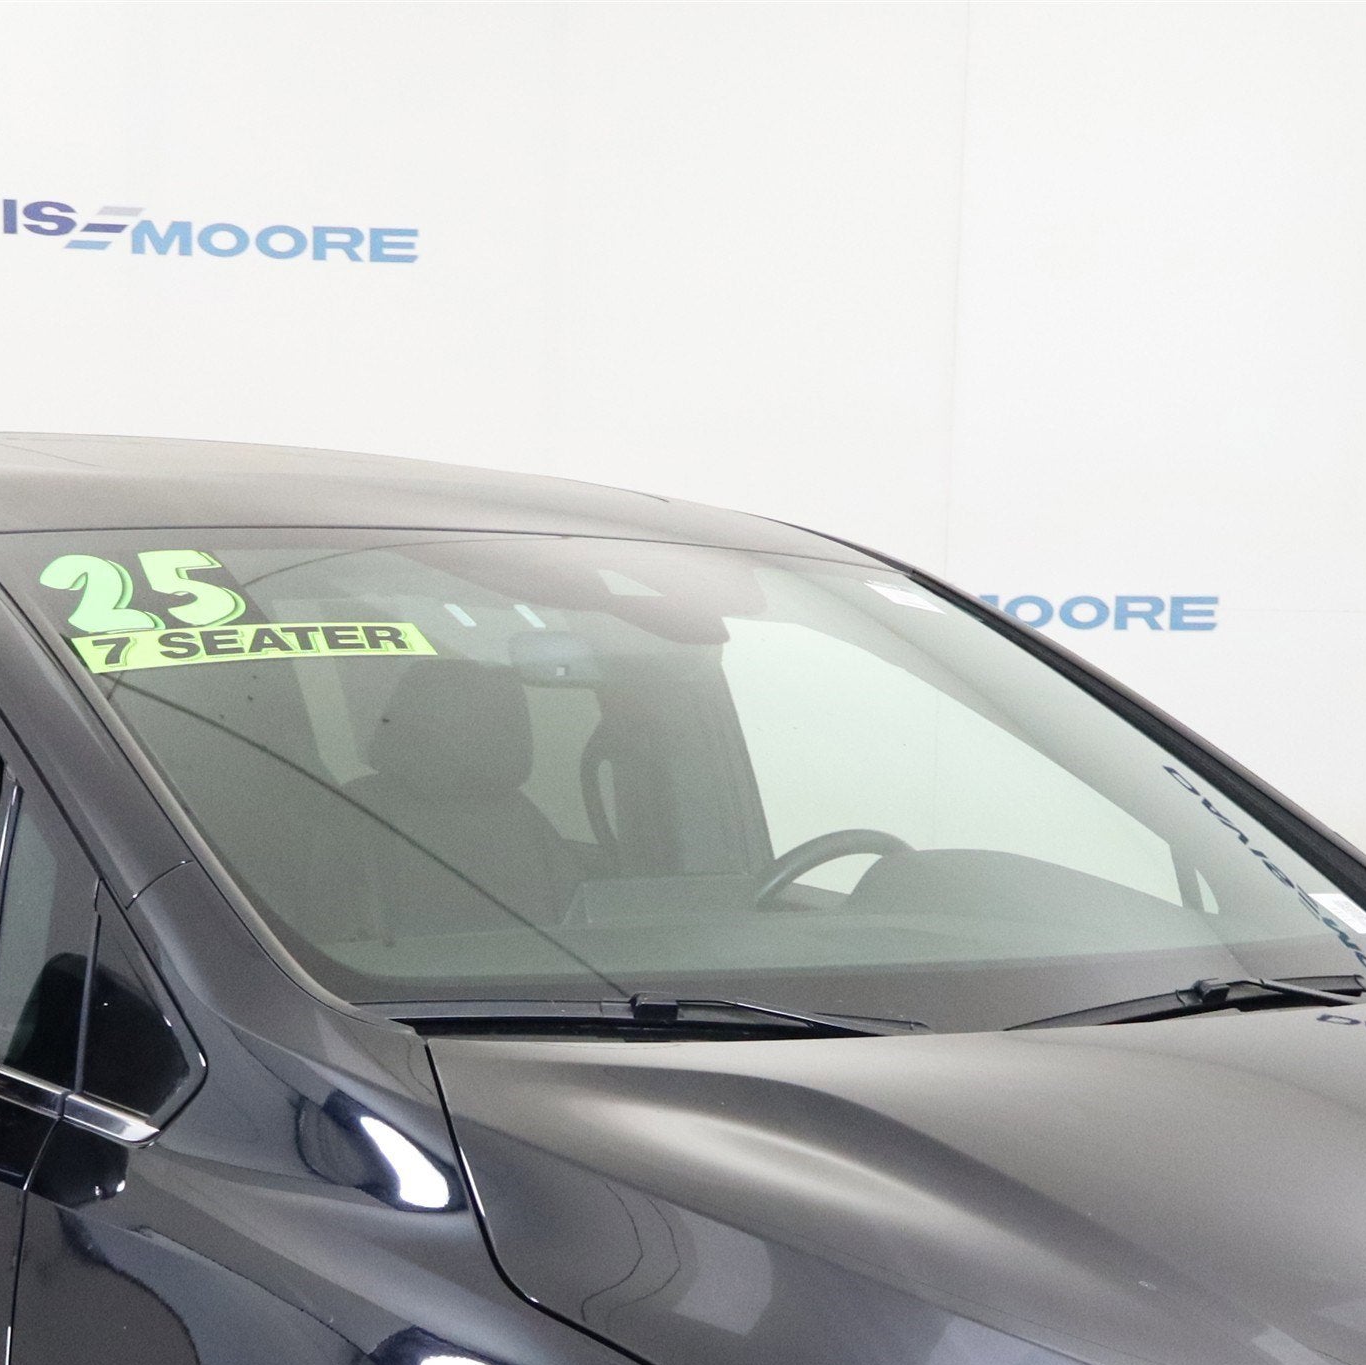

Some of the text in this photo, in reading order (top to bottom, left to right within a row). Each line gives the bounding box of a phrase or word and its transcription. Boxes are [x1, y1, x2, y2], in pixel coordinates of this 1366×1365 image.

[132, 220, 420, 263] MOORE
[40, 549, 247, 634] 25
[979, 595, 1219, 631] OORE
[92, 625, 410, 666] 7 SEATER
